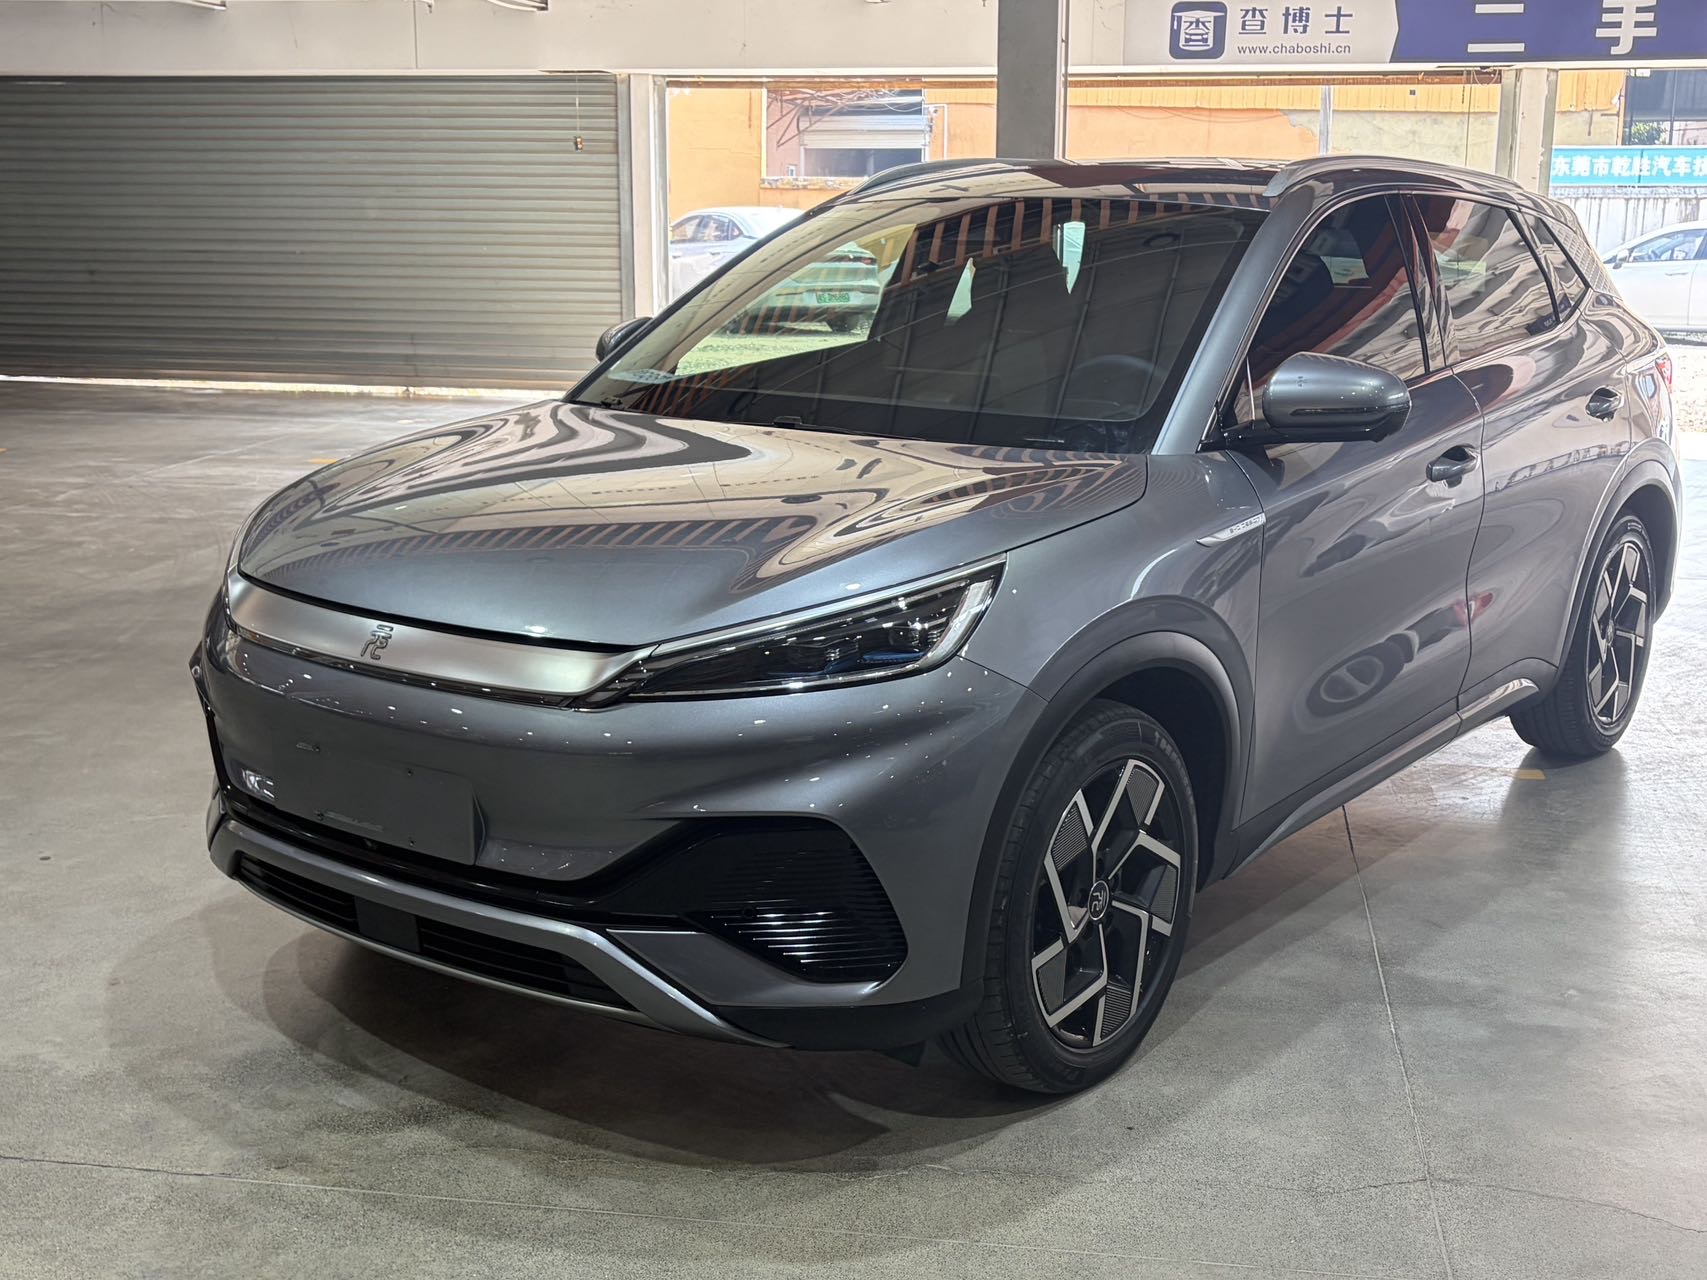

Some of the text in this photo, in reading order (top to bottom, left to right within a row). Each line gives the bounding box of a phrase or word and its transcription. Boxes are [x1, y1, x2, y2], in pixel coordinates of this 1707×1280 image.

[1238, 6, 1353, 35] 查博士
[1467, 0, 1657, 55] 二手
[1237, 43, 1351, 54] www.chaboshi.cn
